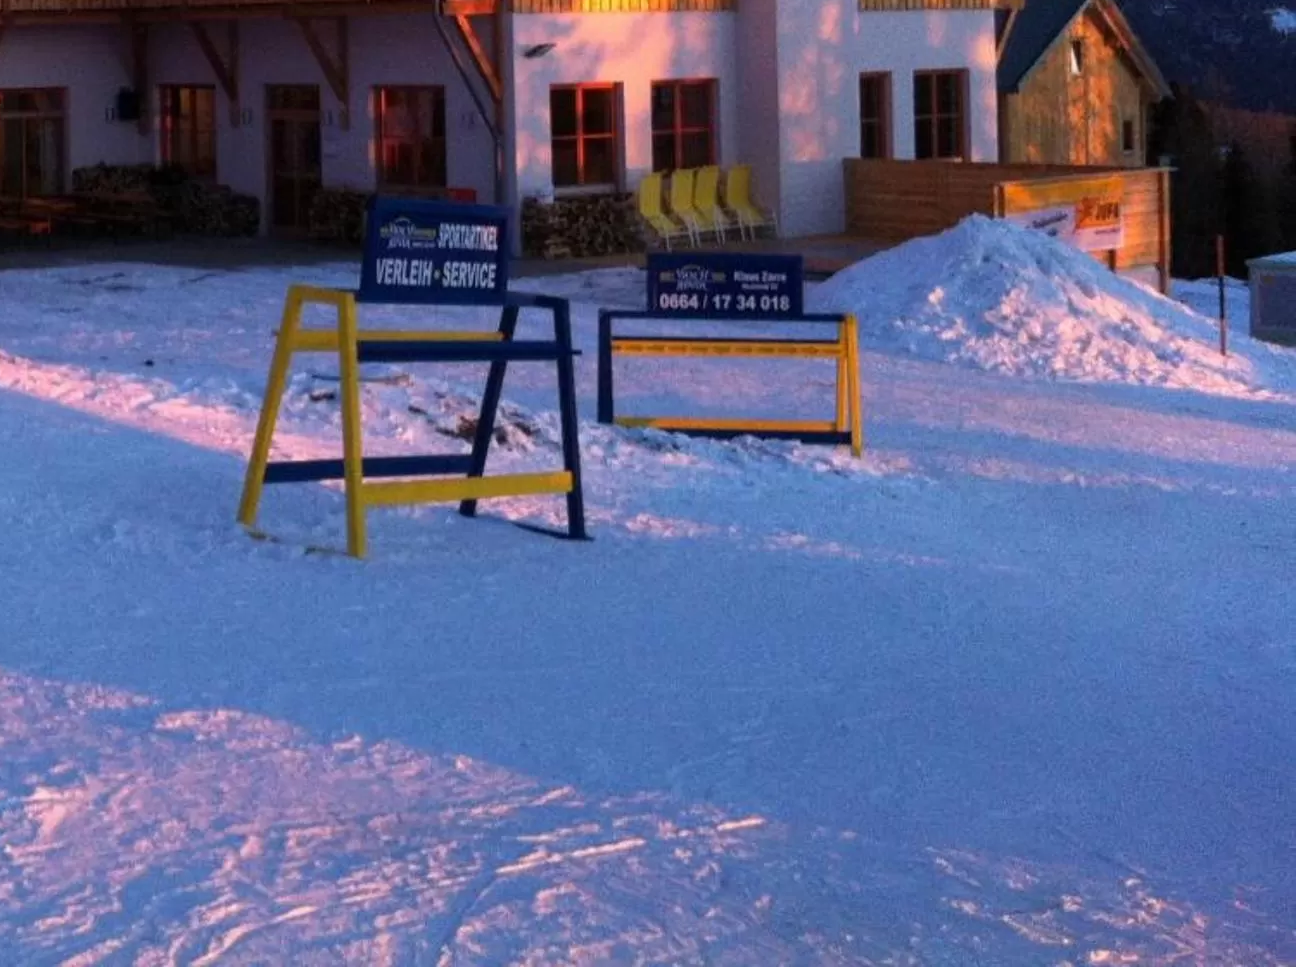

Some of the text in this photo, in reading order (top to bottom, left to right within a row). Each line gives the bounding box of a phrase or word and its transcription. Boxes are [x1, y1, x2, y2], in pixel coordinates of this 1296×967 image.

[438, 223, 497, 250] SPORTARTIKEL
[376, 258, 497, 289] VERLEIH SERVICE
[659, 294, 699, 309] 0664
[712, 294, 731, 310] 17
[736, 295, 756, 310] 34
[760, 295, 790, 311] 018
